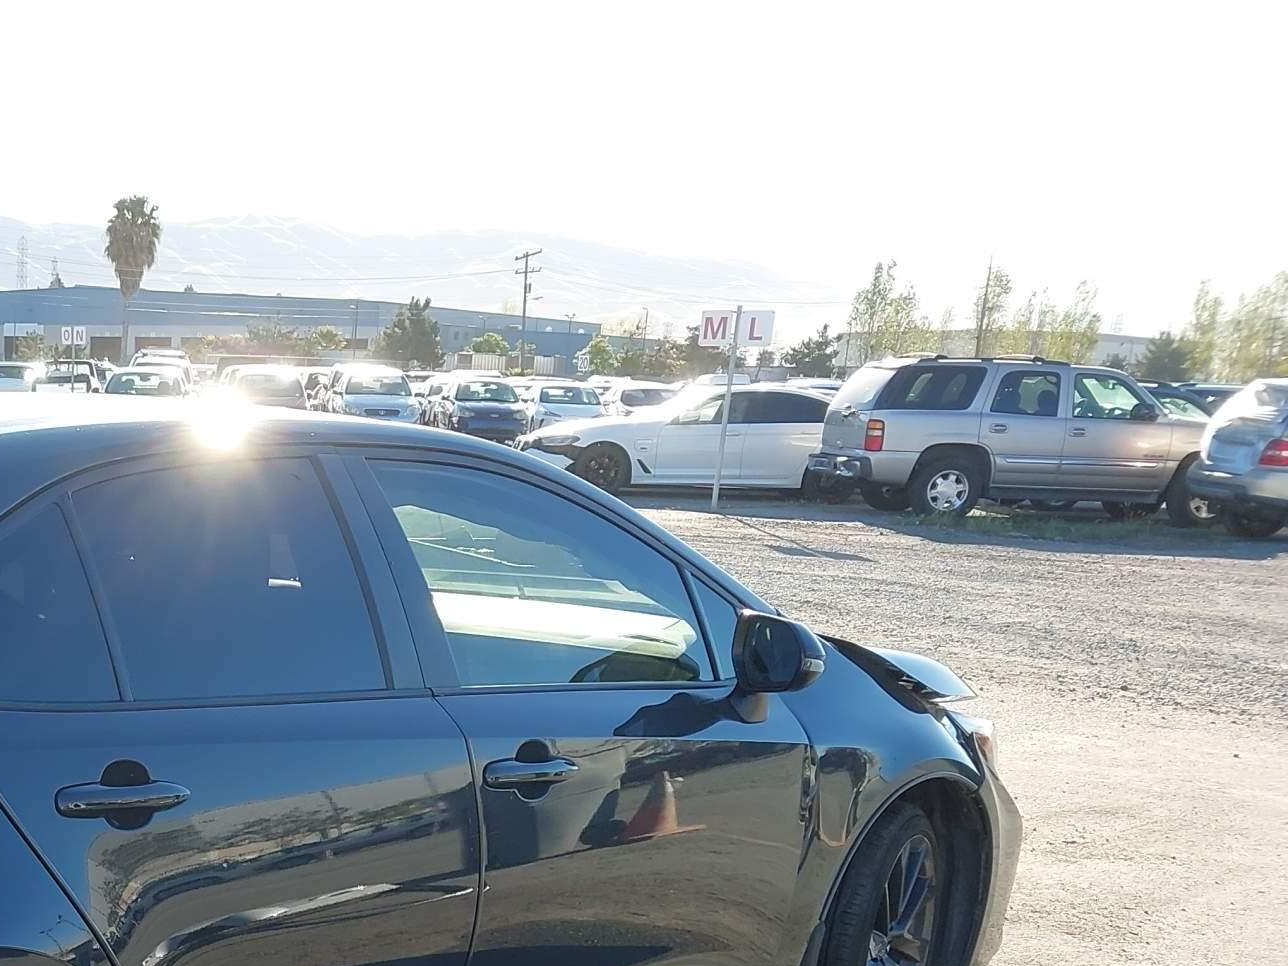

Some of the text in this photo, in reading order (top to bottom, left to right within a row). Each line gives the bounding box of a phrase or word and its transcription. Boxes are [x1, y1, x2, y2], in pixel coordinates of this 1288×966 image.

[703, 316, 763, 340] M L
[578, 356, 589, 370] 20
